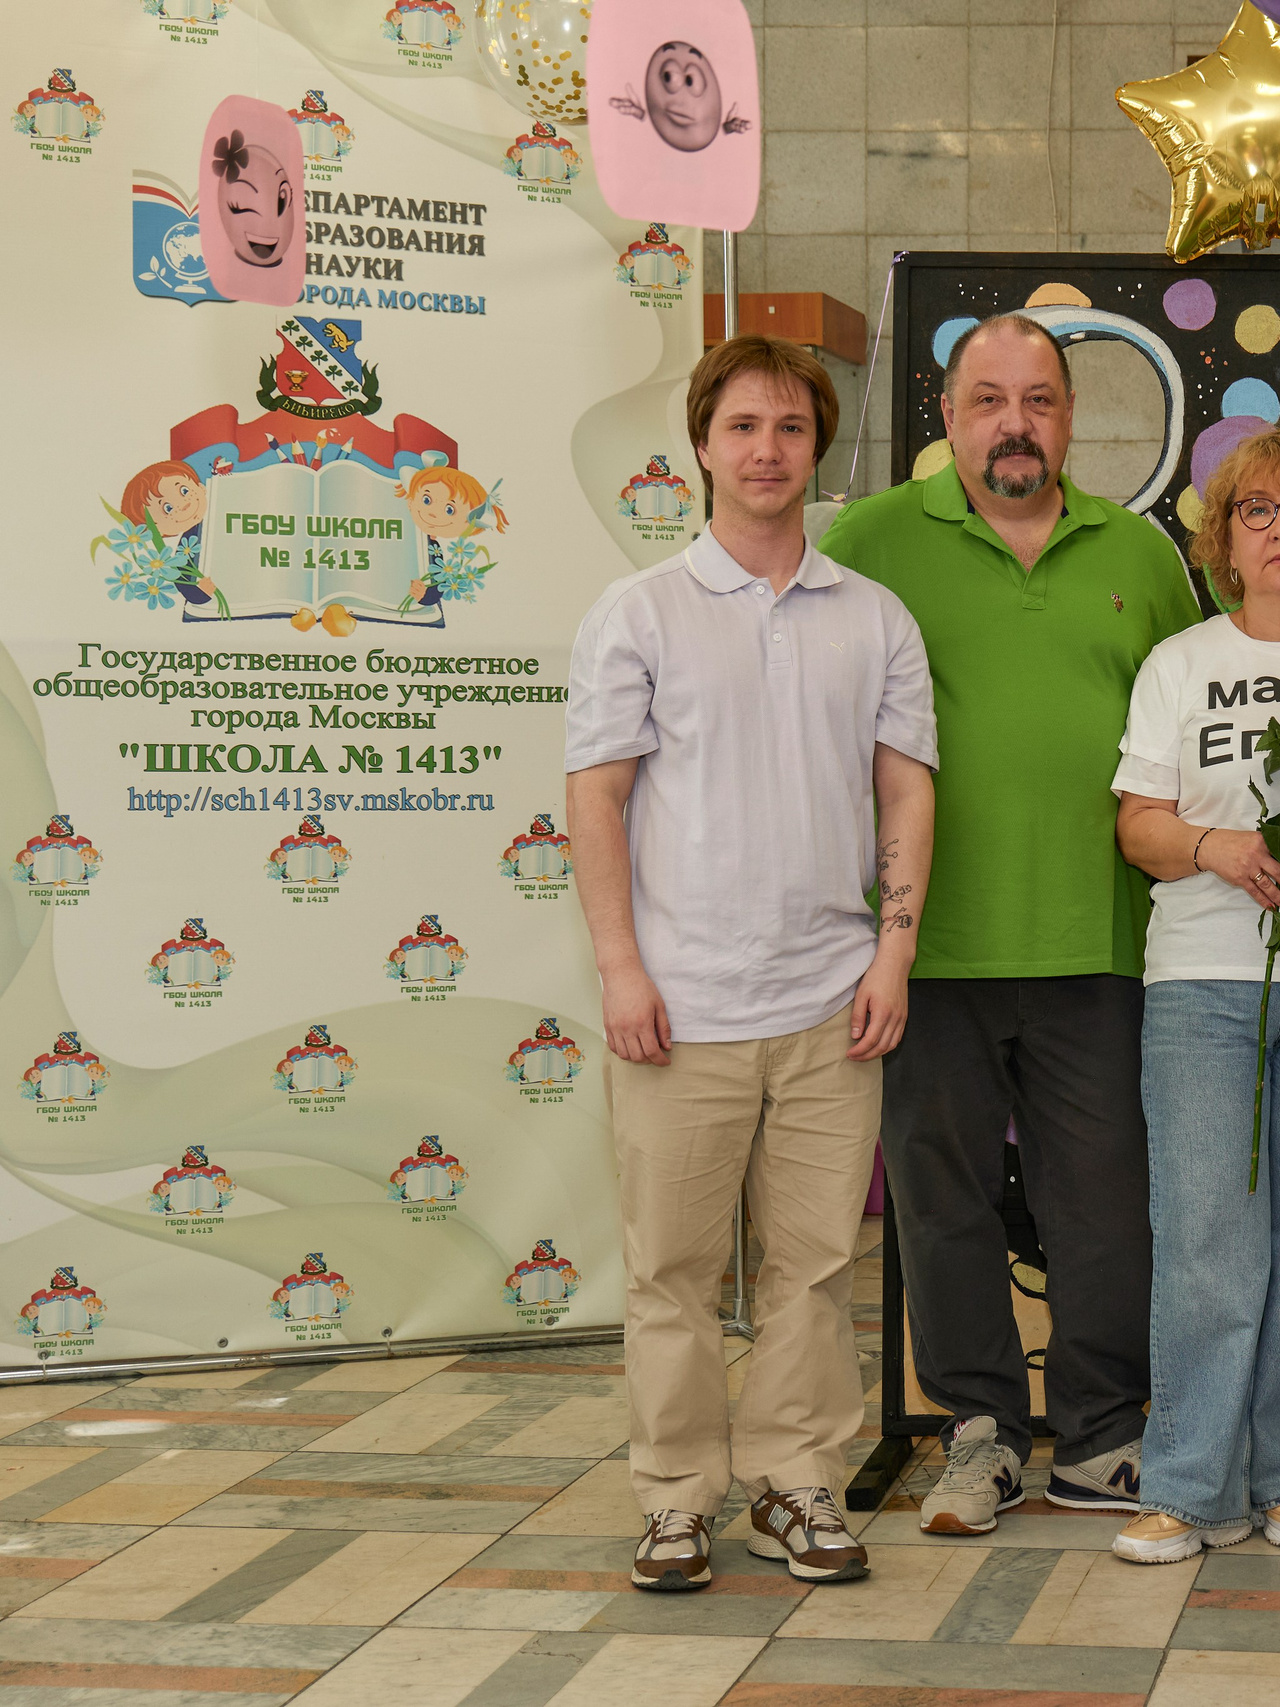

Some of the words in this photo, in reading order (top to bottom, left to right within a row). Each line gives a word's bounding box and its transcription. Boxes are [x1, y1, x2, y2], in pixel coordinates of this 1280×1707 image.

[160, 24, 183, 32] ГБОУ
[187, 27, 219, 36] ШКОЛА
[398, 49, 420, 57] ГБОУ
[423, 52, 453, 61] ШКОЛА
[422, 61, 443, 69] 1413
[31, 143, 55, 151] ГБОУ
[58, 145, 92, 154] ШКОЛА
[57, 155, 80, 163] 1413
[311, 163, 343, 173] ШКОЛА
[310, 173, 332, 181] 1413
[542, 187, 572, 195] ШКОЛА
[377, 288, 486, 315] МОСКВЫ
[226, 513, 295, 536] ГБОУ
[306, 516, 402, 540] ШКОЛА
[260, 546, 290, 568] №
[303, 548, 370, 571] 1413
[78, 643, 357, 676] Государственное
[366, 648, 539, 677] бюджетное
[33, 671, 388, 705] общеобразовательное
[190, 709, 300, 734] города
[308, 704, 436, 730] Москвы
[119, 743, 328, 773] "ШКОЛА
[338, 745, 383, 773] №
[396, 745, 502, 774] 1413"
[127, 786, 495, 817] http://sch1413sv.mskobr.ru
[517, 1309, 537, 1317] ГБОУ
[540, 1307, 570, 1315] ШКОЛА
[768, 1503, 794, 1534] N
